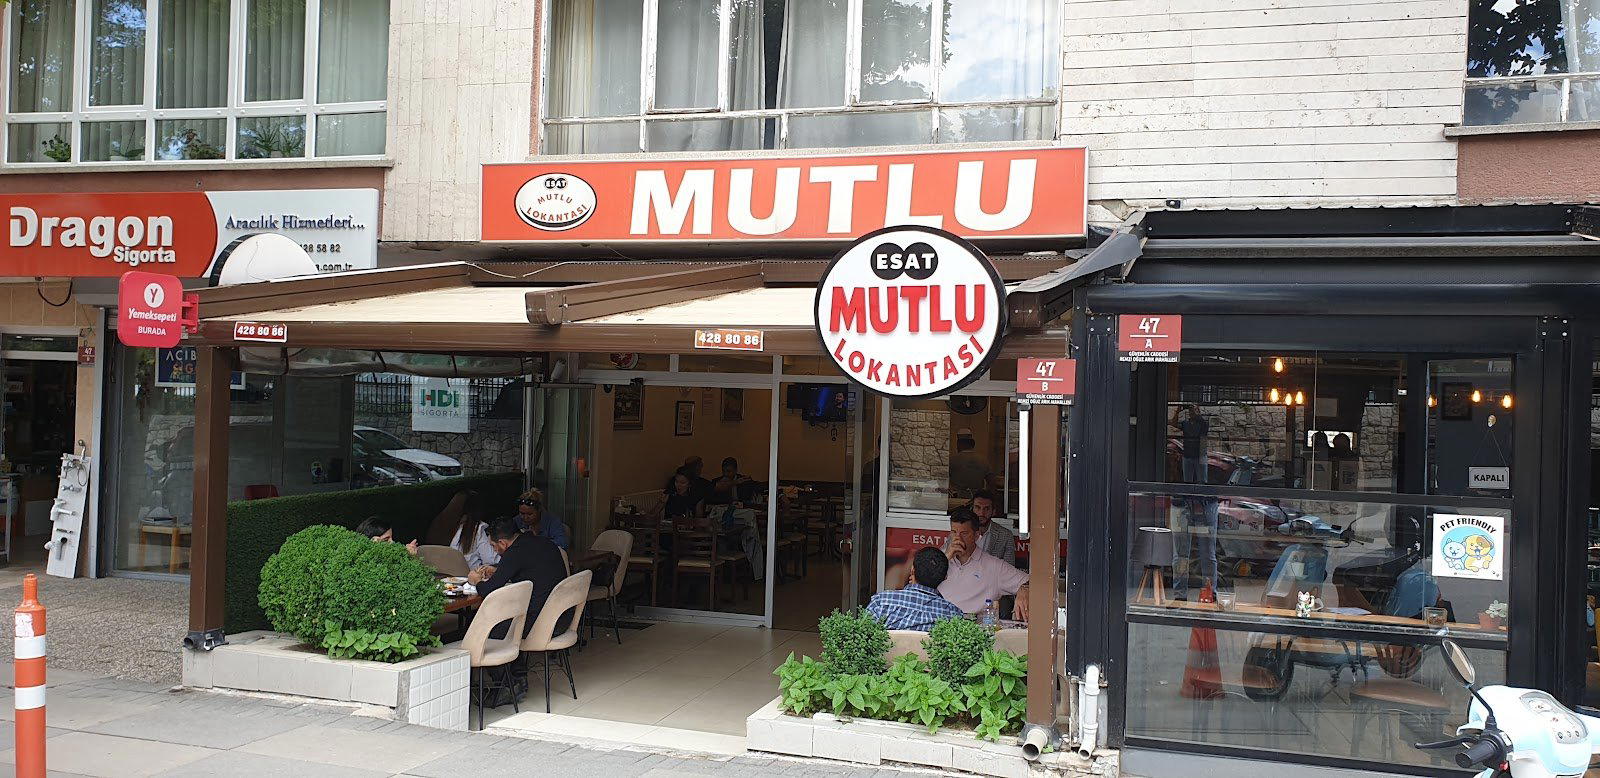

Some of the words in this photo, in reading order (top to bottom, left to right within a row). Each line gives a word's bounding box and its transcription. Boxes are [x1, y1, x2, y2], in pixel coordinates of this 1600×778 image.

[546, 179, 566, 188] ESAT
[537, 193, 573, 204] MUTLU
[629, 158, 1036, 235] MUTLU
[526, 204, 588, 222] LOKANTASI
[225, 214, 279, 230] Aracılık
[281, 213, 366, 230] Hizmetleri...
[10, 206, 174, 258] Dragon
[113, 246, 176, 266] Sigorta
[316, 244, 327, 253] 58
[330, 244, 341, 253] 82
[876, 253, 935, 270] ESAT
[128, 307, 177, 322] Yemeksepeti
[829, 284, 986, 335] MUTLU
[138, 326, 167, 336] BURADA
[237, 325, 255, 335] 428
[257, 326, 270, 336] 80
[272, 326, 284, 337] 86
[1138, 317, 1160, 333] 47
[699, 332, 722, 344] 428
[725, 334, 740, 345] 80
[744, 335, 759, 346] 86
[1145, 338, 1153, 349] A
[165, 349, 197, 361] ACIB
[833, 335, 985, 388] LOKANTASI
[1036, 361, 1056, 377] 47
[1041, 382, 1049, 391] B
[1474, 474, 1505, 482] KAPALI
[1440, 519, 1456, 531] PET
[1456, 517, 1497, 534] FRIENDLY
[912, 534, 941, 545] ESAT
